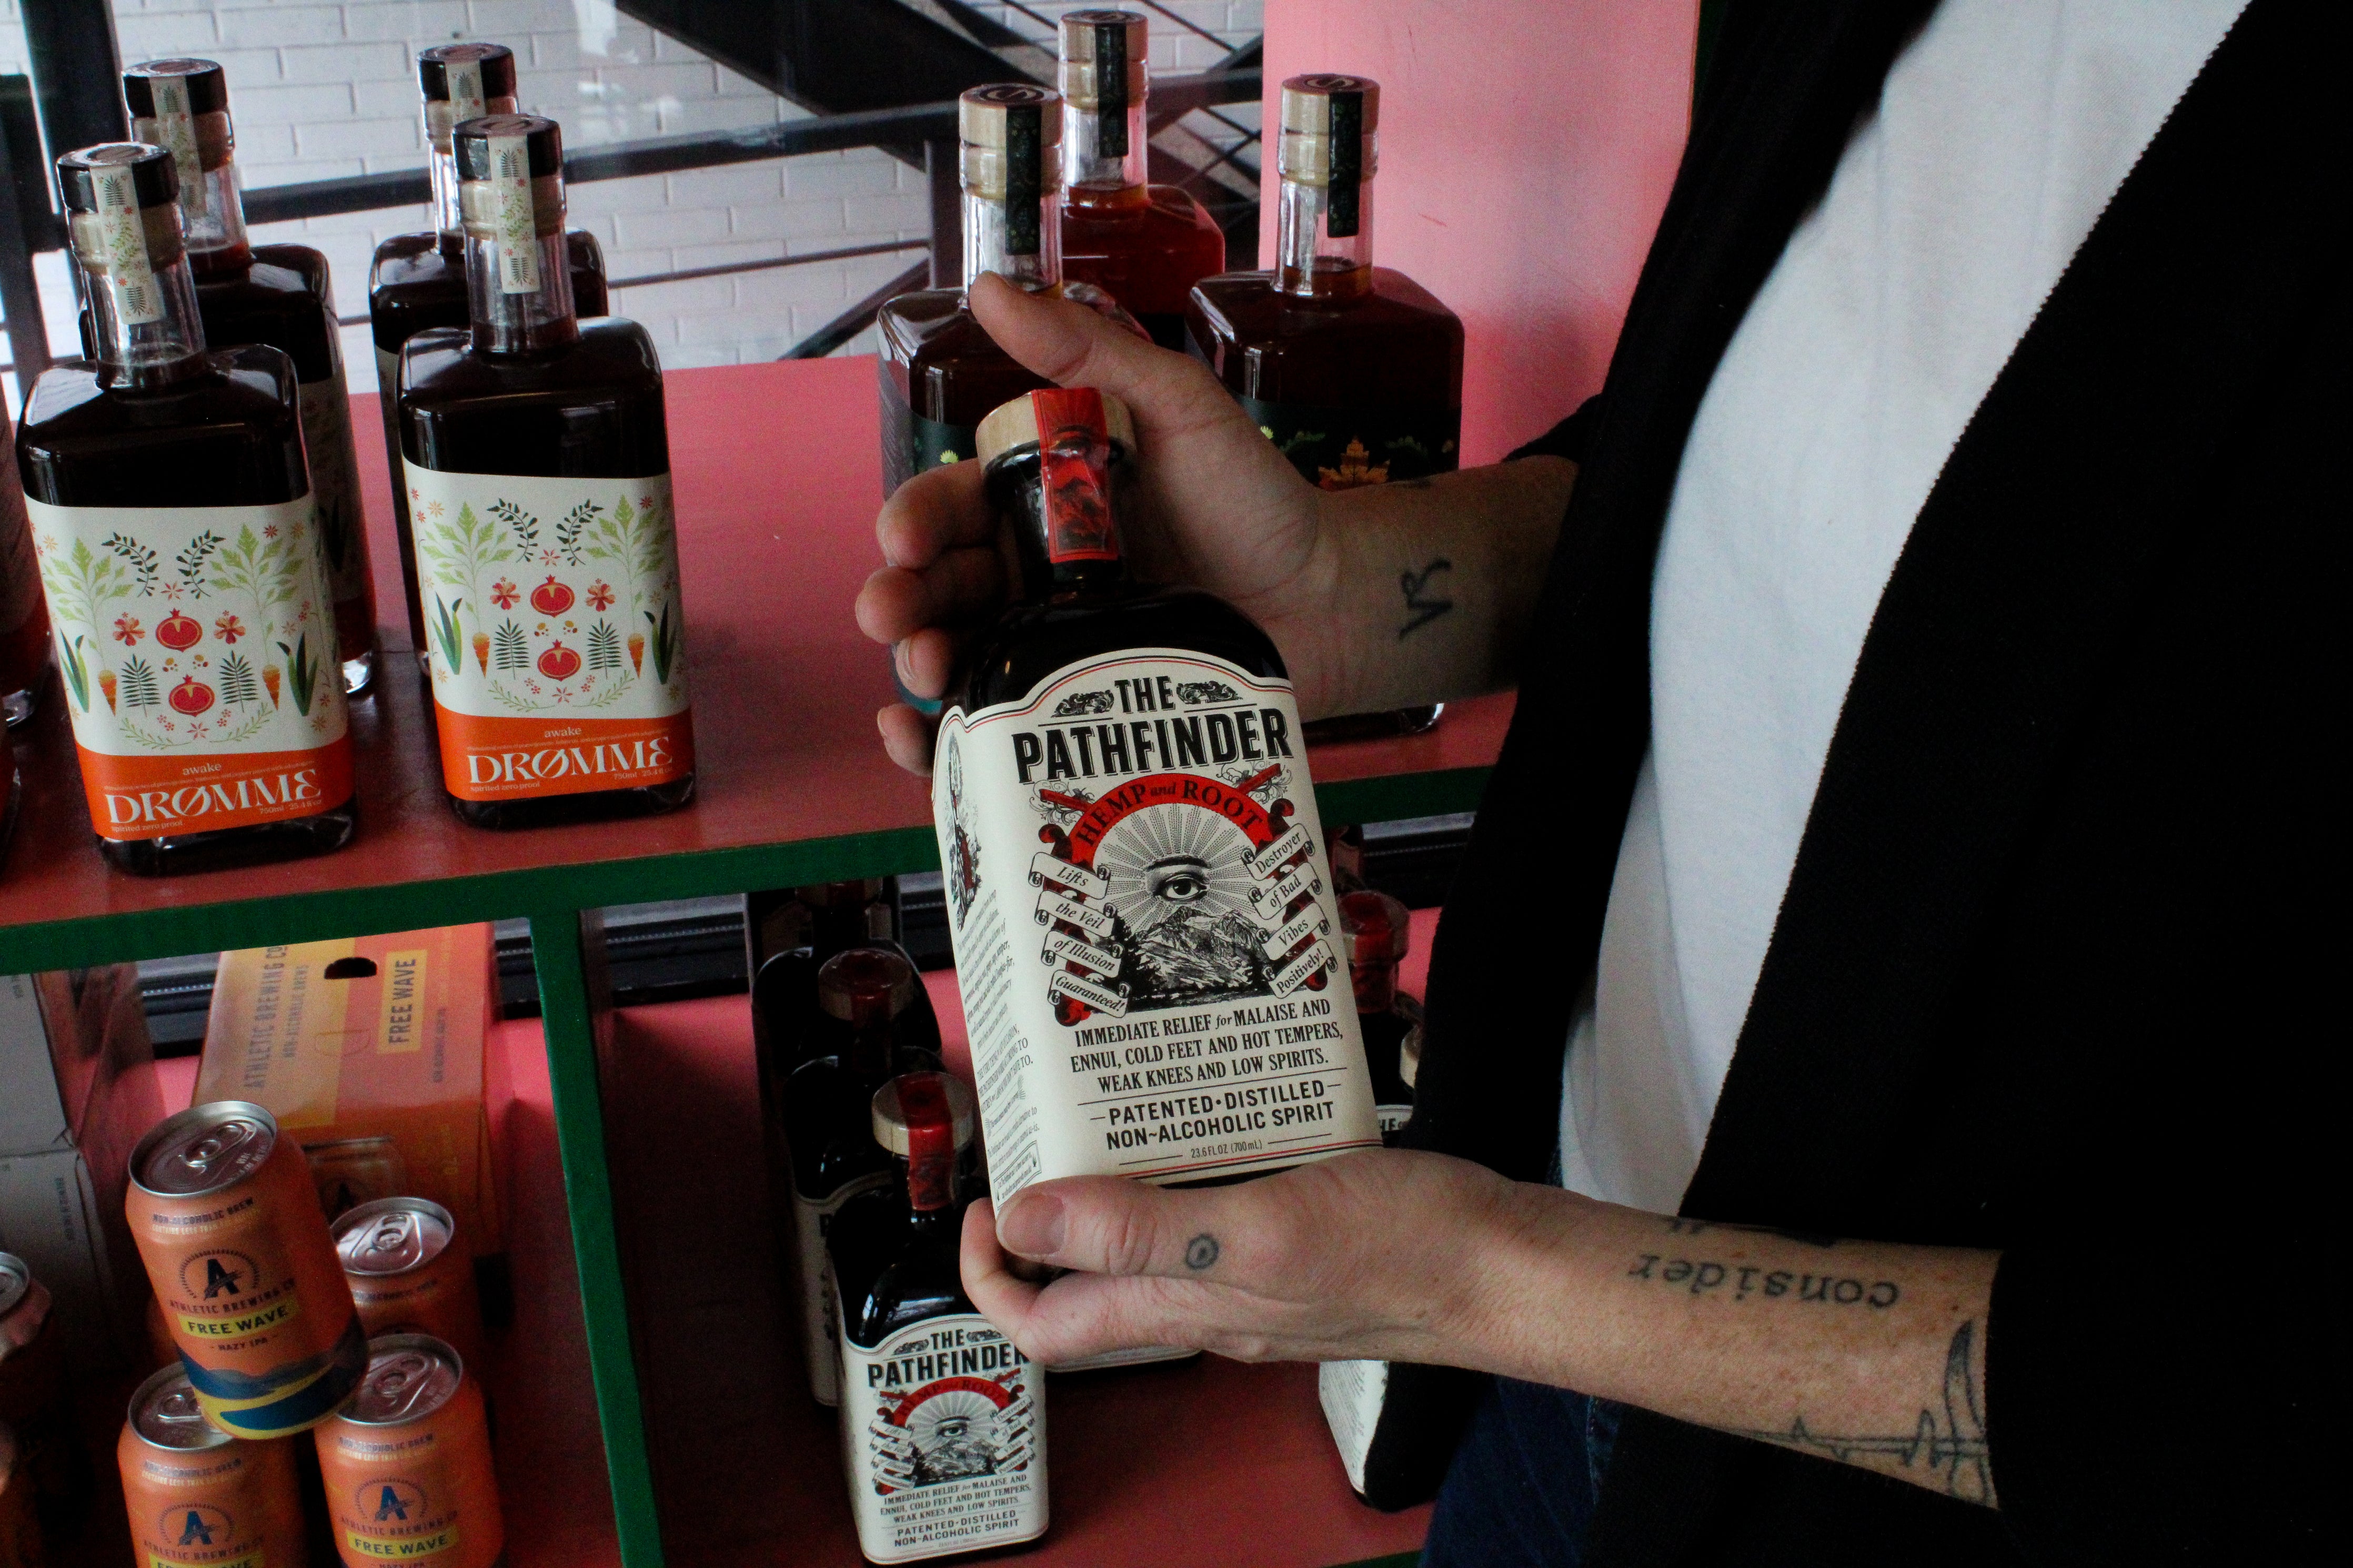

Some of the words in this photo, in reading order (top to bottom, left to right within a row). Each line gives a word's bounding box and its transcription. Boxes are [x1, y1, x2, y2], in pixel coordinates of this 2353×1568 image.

[1114, 676, 1176, 714] THE
[545, 726, 581, 738] awake
[1011, 708, 1294, 785] PATHFINDER
[183, 763, 222, 775] awake
[1075, 784, 1147, 847] HEMP
[1150, 783, 1177, 797] and
[1182, 778, 1263, 832] ROOT
[112, 824, 140, 833] spirited
[1254, 831, 1301, 874] Destroyer
[1056, 866, 1089, 890] Lifts
[1269, 892, 1285, 909] of
[1281, 874, 1301, 896] Bad
[1055, 898, 1079, 918] the
[1080, 906, 1105, 930] Veil
[1278, 918, 1310, 947] Vibes
[1053, 937, 1070, 953] of
[1070, 941, 1116, 971] Illusion
[392, 958, 416, 1002] WAVE
[1275, 950, 1324, 994] Positively!
[1054, 975, 1125, 1012] Guaranteed!
[388, 1004, 413, 1045] FREE
[1074, 1020, 1158, 1048] IMMEDIATE
[1162, 1014, 1211, 1035] RELIEF
[1215, 1014, 1232, 1031] for
[1233, 1004, 1298, 1027] MALAISE
[1302, 998, 1330, 1018] AND
[1018, 1037, 1028, 1050] TO
[1070, 1050, 1122, 1073] ENNUI,
[1125, 1045, 1163, 1066] COLD
[1167, 1039, 1202, 1060] FEET
[1209, 1035, 1238, 1055] AND
[1240, 1030, 1271, 1050] HOT
[1273, 1021, 1343, 1046] TEMPERS,
[1021, 1055, 1033, 1068] TO.
[1097, 1073, 1143, 1094] WEAK
[1146, 1067, 1193, 1088] KNEES
[1196, 1061, 1226, 1080] AND
[1232, 1057, 1263, 1076] LOW
[1270, 1047, 1329, 1071] SPIRITS.
[1272, 1101, 1334, 1127] SPIRIT
[227, 1197, 254, 1215] BREW
[1626, 1251, 1902, 1310] consider
[169, 1299, 219, 1314] ATHLETIC
[222, 1288, 281, 1313] BREWING
[187, 1321, 233, 1335] FREE
[235, 1305, 288, 1332] WAVE
[218, 1342, 246, 1351] HAZY
[250, 1337, 267, 1347] IPA
[930, 1328, 966, 1351] THE
[884, 1491, 930, 1505] IMMEDIATE
[932, 1484, 960, 1498] RELIEF
[961, 1483, 971, 1492] for
[972, 1477, 1007, 1490] MALAISE
[1010, 1474, 1027, 1484] AND
[909, 1501, 931, 1511] COLD
[933, 1496, 953, 1506] FEET
[956, 1492, 973, 1502] AND
[974, 1489, 991, 1499] HOT
[893, 1513, 917, 1523] WEAK
[920, 1509, 946, 1520] KNEES
[948, 1505, 964, 1515] AND
[967, 1501, 985, 1511] LOW
[354, 1537, 395, 1555] FREE
[399, 1534, 448, 1555] WAVE
[894, 1525, 982, 1547] NON-ALCOHOLIC
[985, 1518, 1020, 1532] SPIRIT
